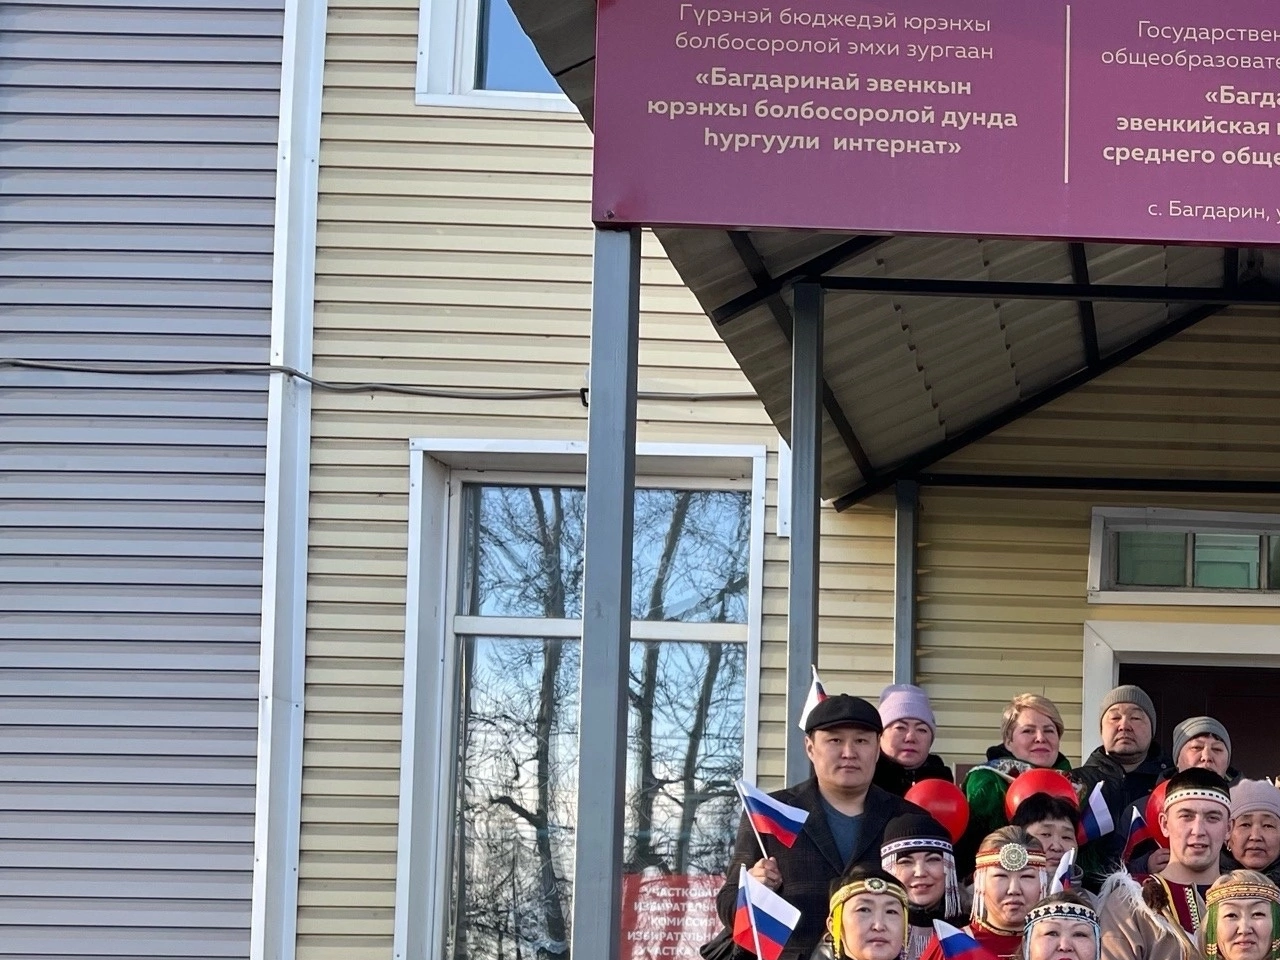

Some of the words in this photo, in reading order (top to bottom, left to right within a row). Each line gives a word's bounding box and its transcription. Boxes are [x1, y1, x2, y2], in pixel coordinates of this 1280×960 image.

[680, 3, 772, 27] Гүрэнэй
[779, 7, 897, 31] бюджедэй
[904, 16, 991, 35] юрэнхы
[675, 31, 840, 57] болбосоролой
[847, 41, 900, 56] эмхи
[906, 43, 993, 63] зургаан
[695, 66, 860, 94] «Багдаринай
[866, 77, 972, 95] эвенкын
[647, 100, 748, 120] юрэнхы
[754, 98, 935, 127] болбосоролой
[941, 110, 1018, 131] дунда
[1116, 115, 1270, 136] эвенкийская
[833, 136, 962, 158] интернат»
[1102, 146, 1216, 166] среднего
[1147, 203, 1163, 217] с.
[1169, 200, 1270, 223] Багдарин,
[634, 901, 718, 912] ИЗБИРАТЕЛЬН
[650, 917, 717, 927] КОМИССИЯ
